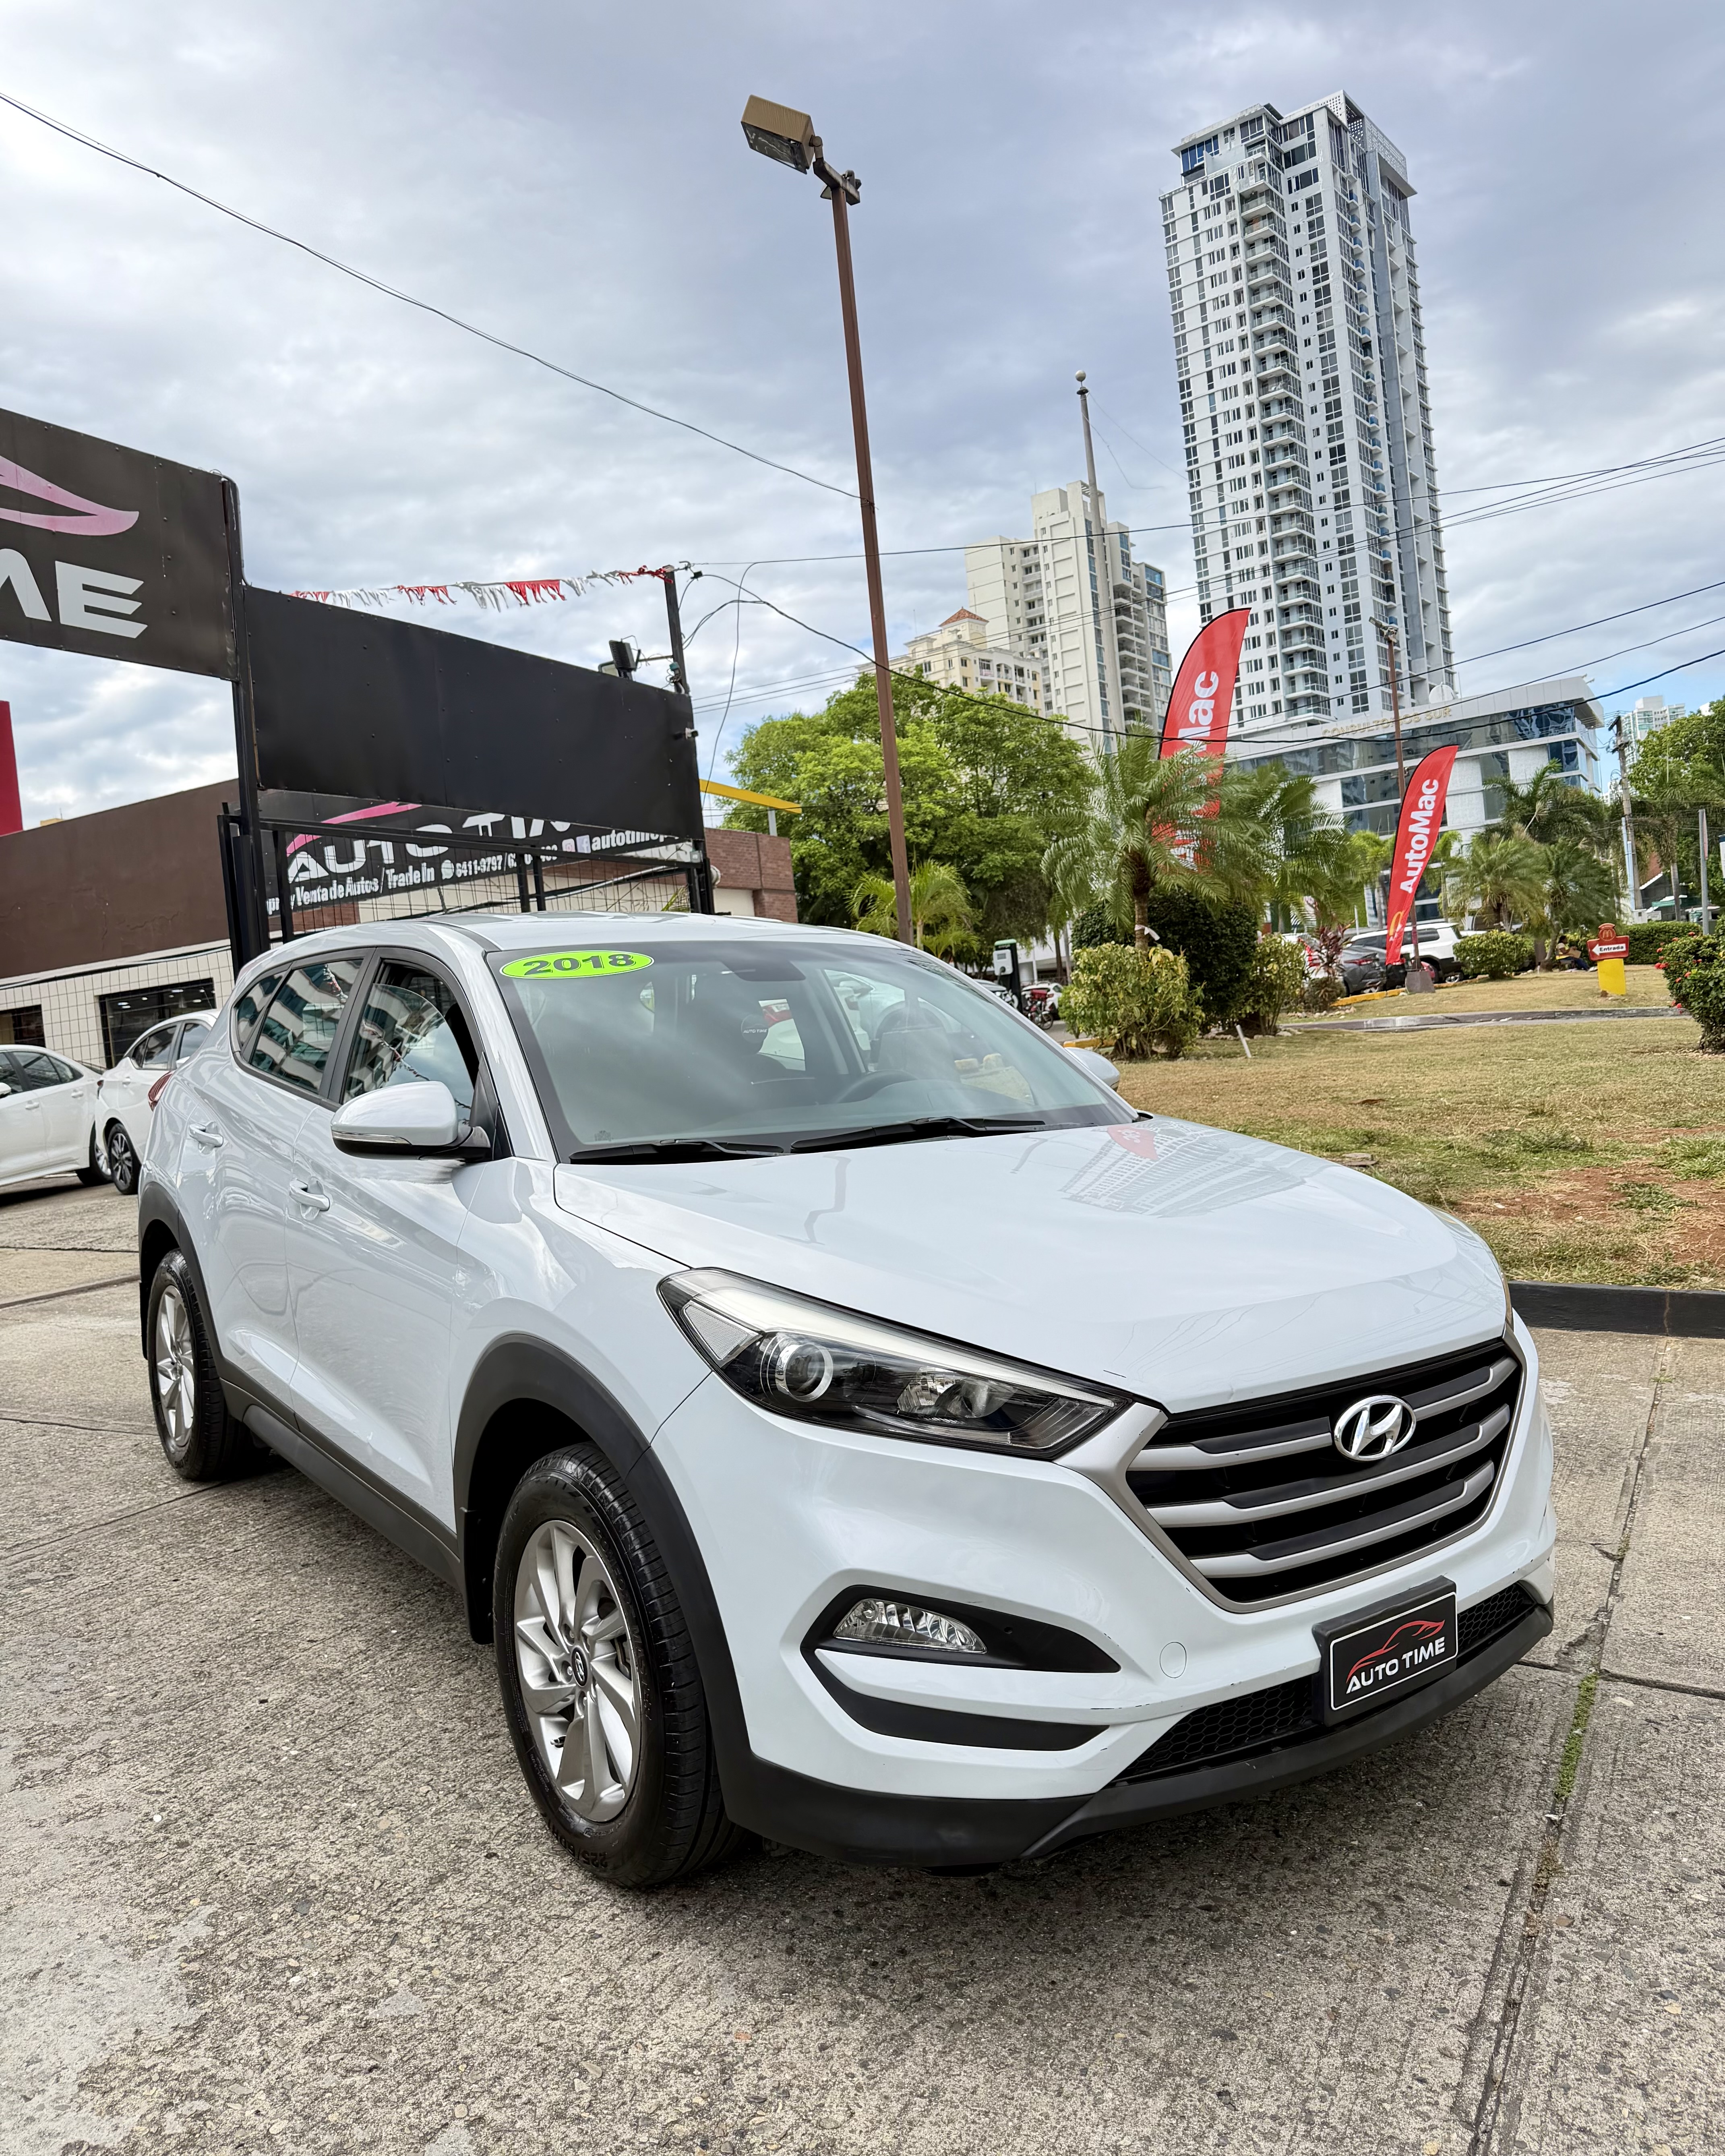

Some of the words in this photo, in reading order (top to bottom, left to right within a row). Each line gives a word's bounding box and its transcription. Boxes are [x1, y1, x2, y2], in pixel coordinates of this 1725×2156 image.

[1425, 707, 1452, 720] SUR
[1400, 778, 1439, 894] AutoMac
[296, 886, 329, 906] Venta
[329, 879, 345, 900] de
[345, 876, 379, 897] Autos
[385, 865, 421, 890] Trade
[421, 862, 435, 883] In
[523, 954, 637, 976] 2018
[1346, 1658, 1399, 1695] AUTO
[1401, 1636, 1446, 1669] TIME
